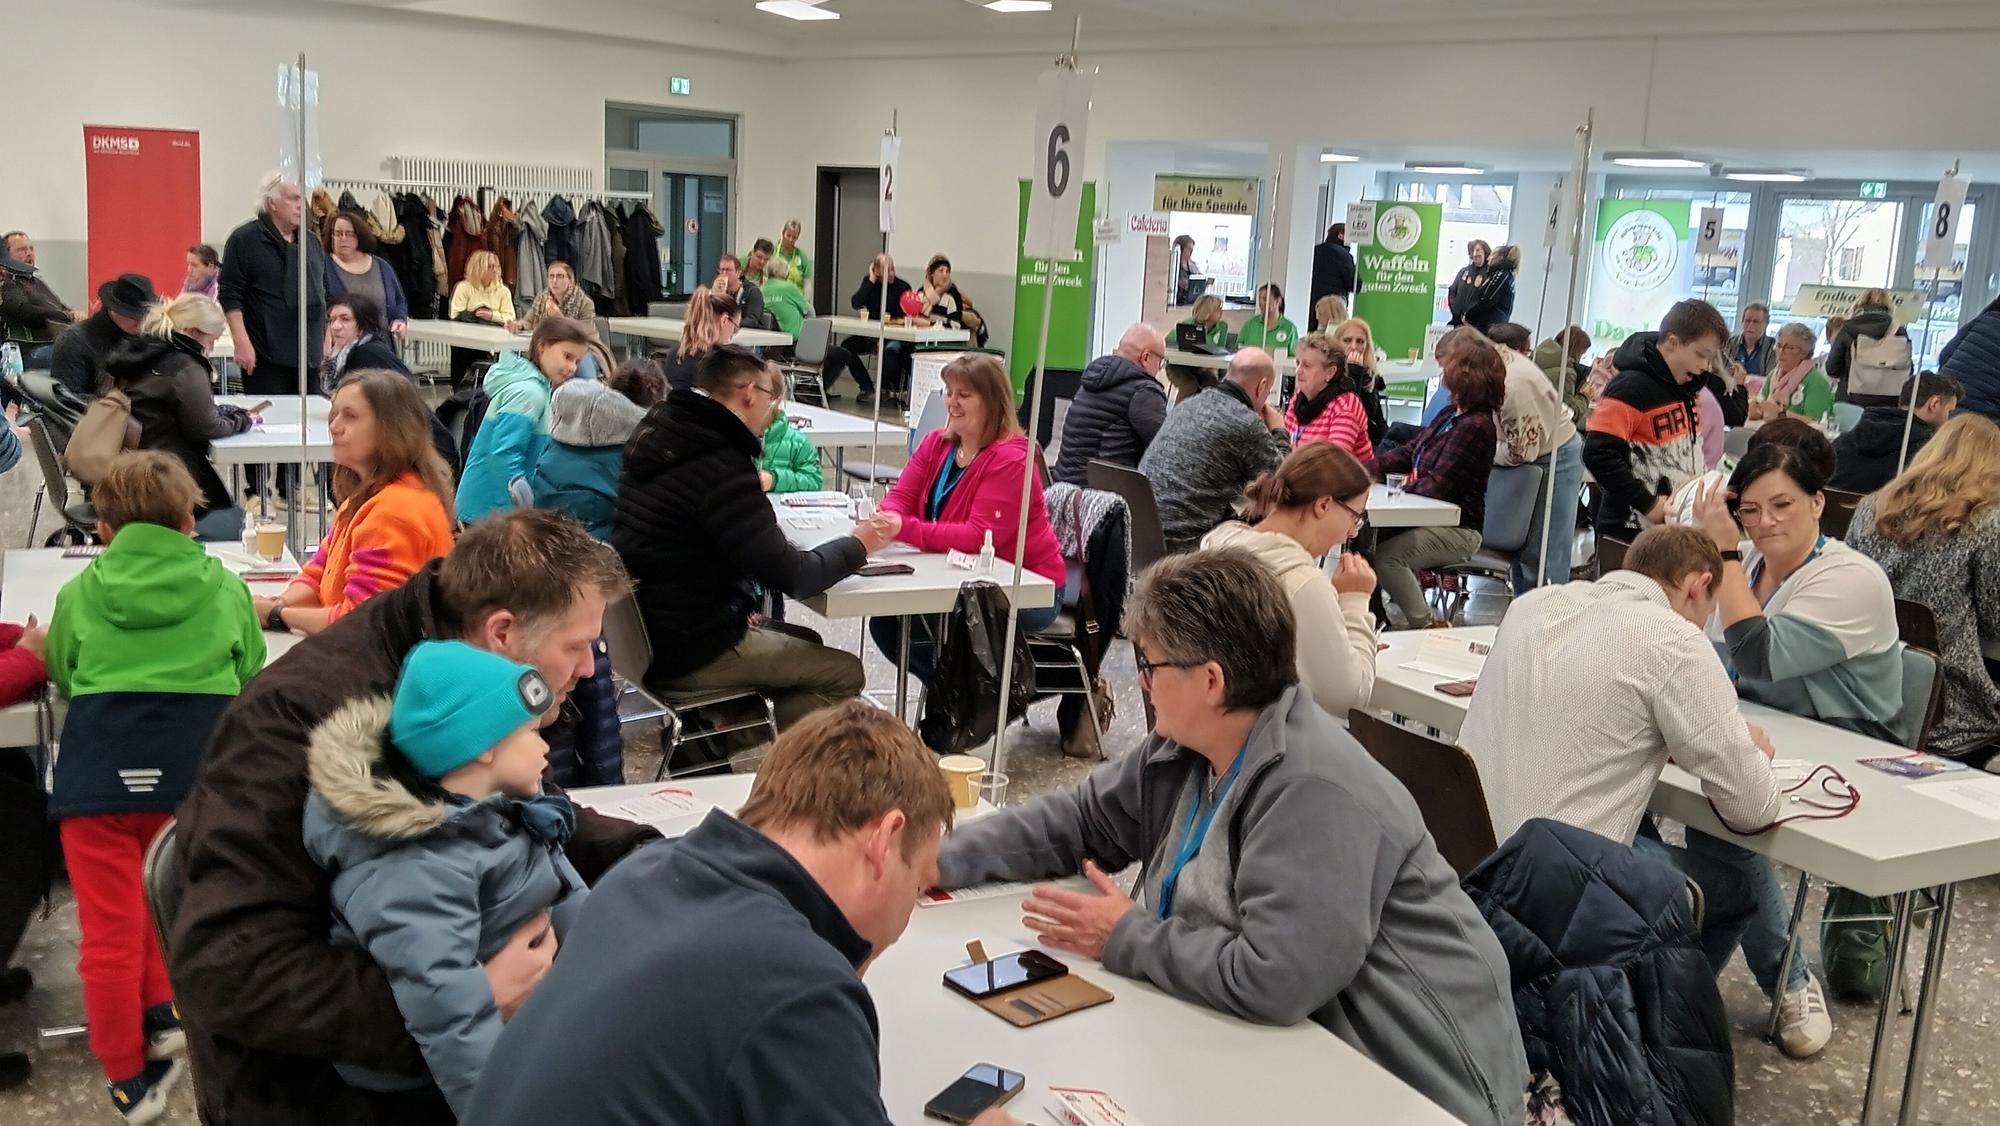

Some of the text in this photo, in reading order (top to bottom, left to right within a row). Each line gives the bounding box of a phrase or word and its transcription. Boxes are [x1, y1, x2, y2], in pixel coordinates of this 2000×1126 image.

[92, 136, 128, 150] DKMS
[1047, 123, 1070, 198] 6
[884, 164, 893, 200] 2
[1187, 183, 1223, 197] Danke
[1162, 195, 1248, 213] für Ihre Spende
[1131, 214, 1168, 232] Cafeteria
[1352, 220, 1368, 230] LEO
[1549, 204, 1558, 229] 4
[1936, 203, 1950, 238] 8
[1705, 221, 1716, 240] 5
[1363, 255, 1429, 272] Waffeln
[1376, 270, 1414, 283] für den
[1392, 282, 1428, 294] Zweck
